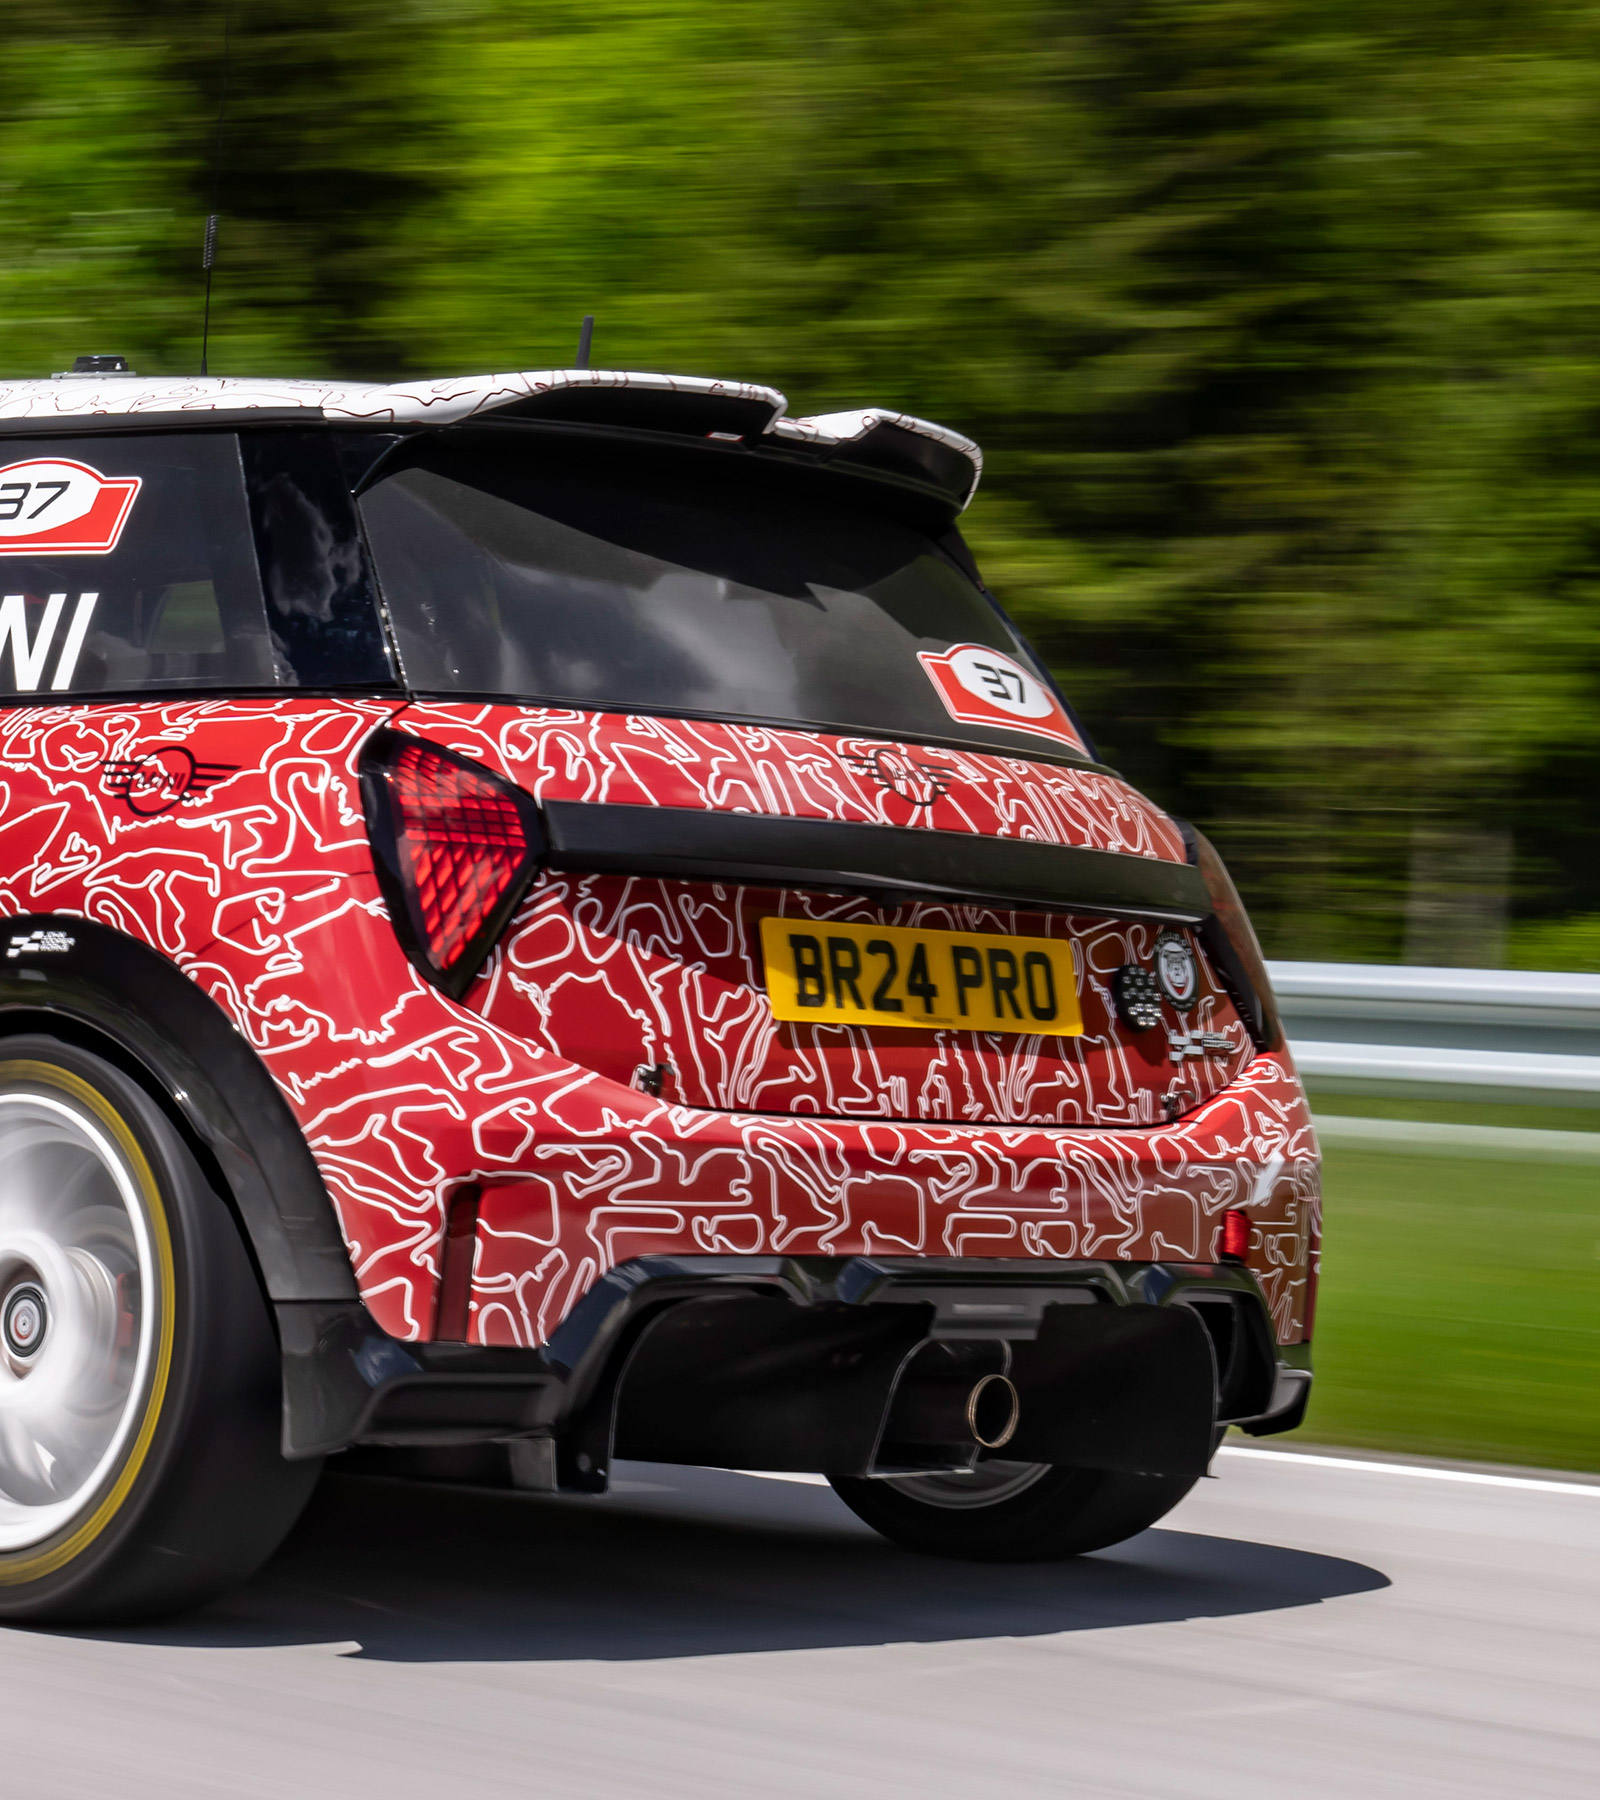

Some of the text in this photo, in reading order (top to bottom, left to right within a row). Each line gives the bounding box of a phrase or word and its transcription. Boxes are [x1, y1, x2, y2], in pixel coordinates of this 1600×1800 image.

[972, 662, 1026, 704] 37
[788, 933, 1057, 1021] BR24 PRO
